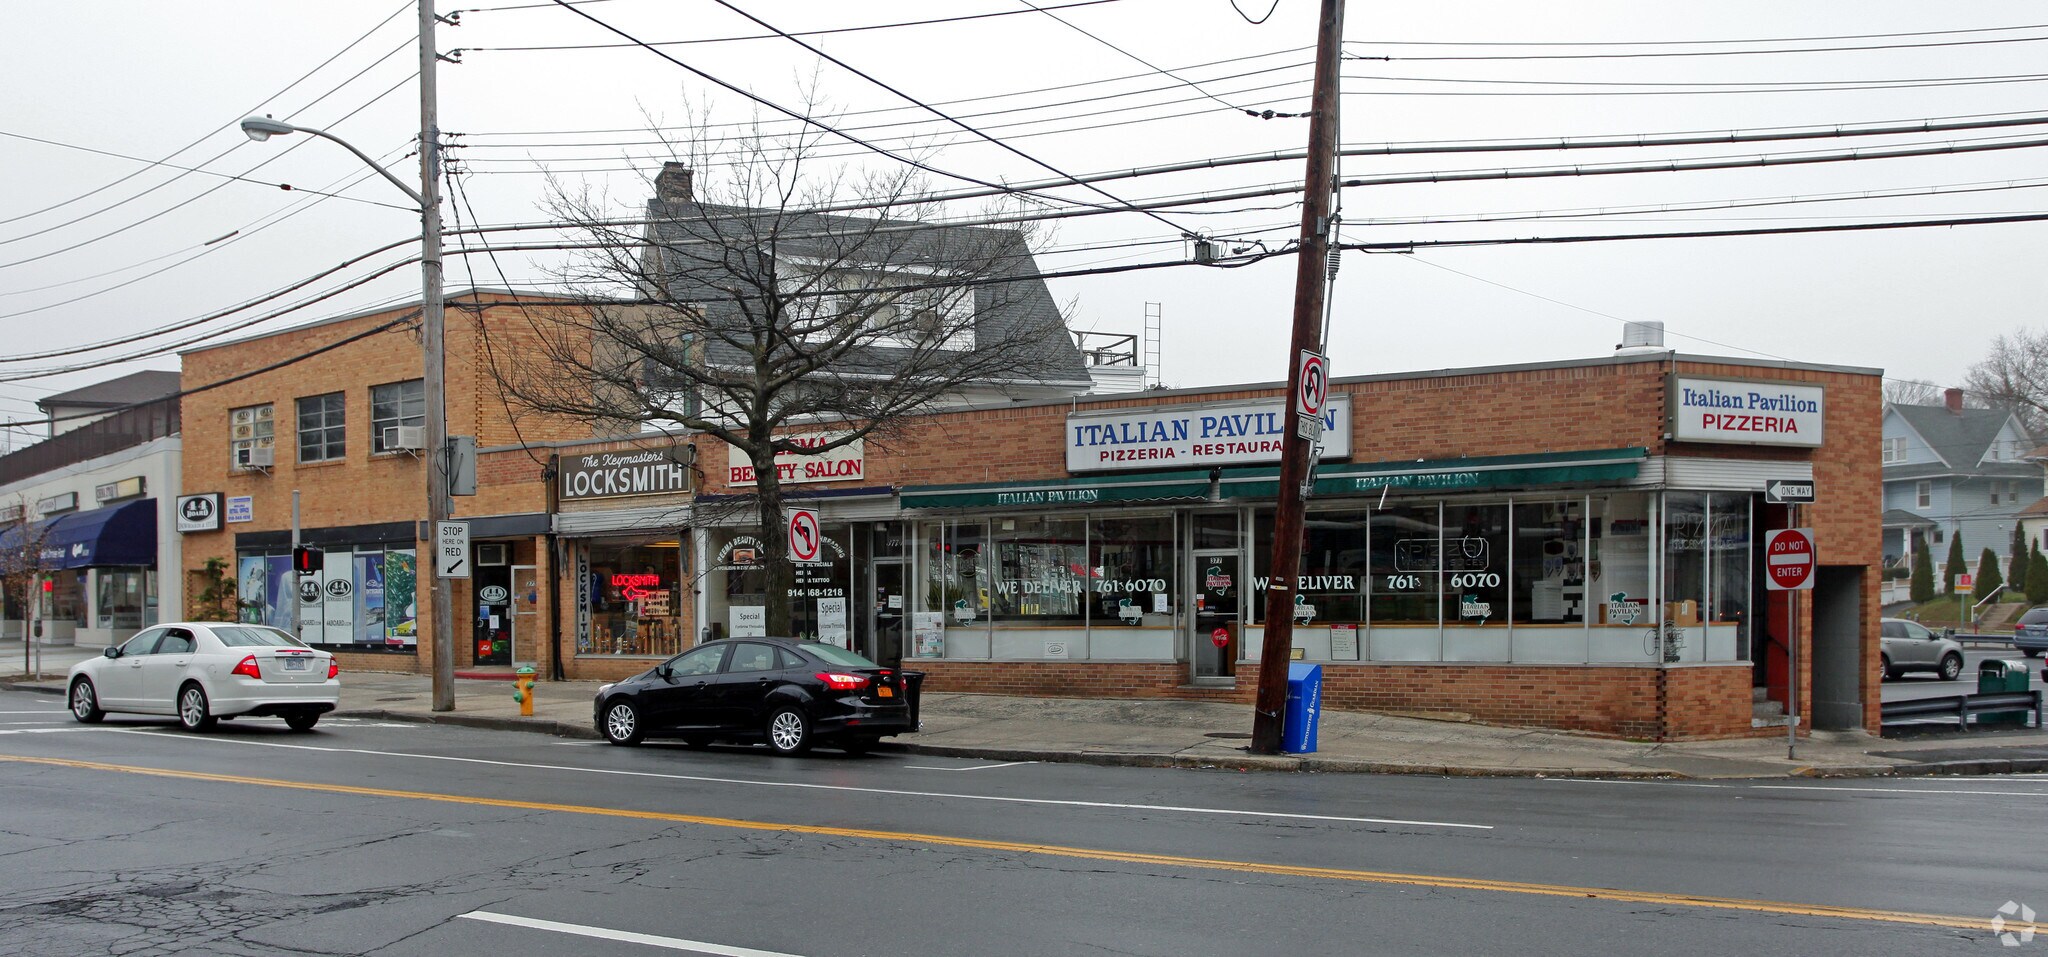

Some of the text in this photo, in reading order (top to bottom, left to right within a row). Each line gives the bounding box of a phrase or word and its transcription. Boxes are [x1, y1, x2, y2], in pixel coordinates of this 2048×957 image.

[1683, 388, 1818, 413] Italian Pavilion
[1074, 409, 1337, 446] ITALIAN PAVILN
[1703, 413, 1798, 433] PIZZERIA
[1100, 447, 1176, 461] PIZZERIA
[1193, 440, 1283, 455] RESTAURA
[581, 451, 663, 468] The Keymasters
[730, 459, 862, 482] BETY SALON
[565, 464, 682, 497] LOCKSMITH
[1355, 472, 1479, 488] ITALIAN PAVILION
[998, 489, 1098, 504] ITALIAN PAVILION
[1781, 487, 1810, 495] ONE WAY
[187, 500, 207, 510] 44
[187, 509, 208, 518] BOARD
[443, 527, 463, 536] STOP
[733, 536, 757, 547] BEAUTY
[1774, 541, 1804, 551] DO NOT
[445, 547, 461, 557] RED
[1776, 567, 1802, 577] ENTER
[611, 574, 660, 586] LOCKSMITH
[995, 580, 1082, 594] WE DELIVER
[1298, 575, 1355, 590] ELIVER
[1450, 573, 1500, 588] 6070
[302, 583, 316, 592] 44
[787, 588, 843, 597] 914-68-1218
[579, 555, 588, 640] LOCKSMITH
[739, 612, 760, 621] Special
[821, 601, 843, 618] Special
